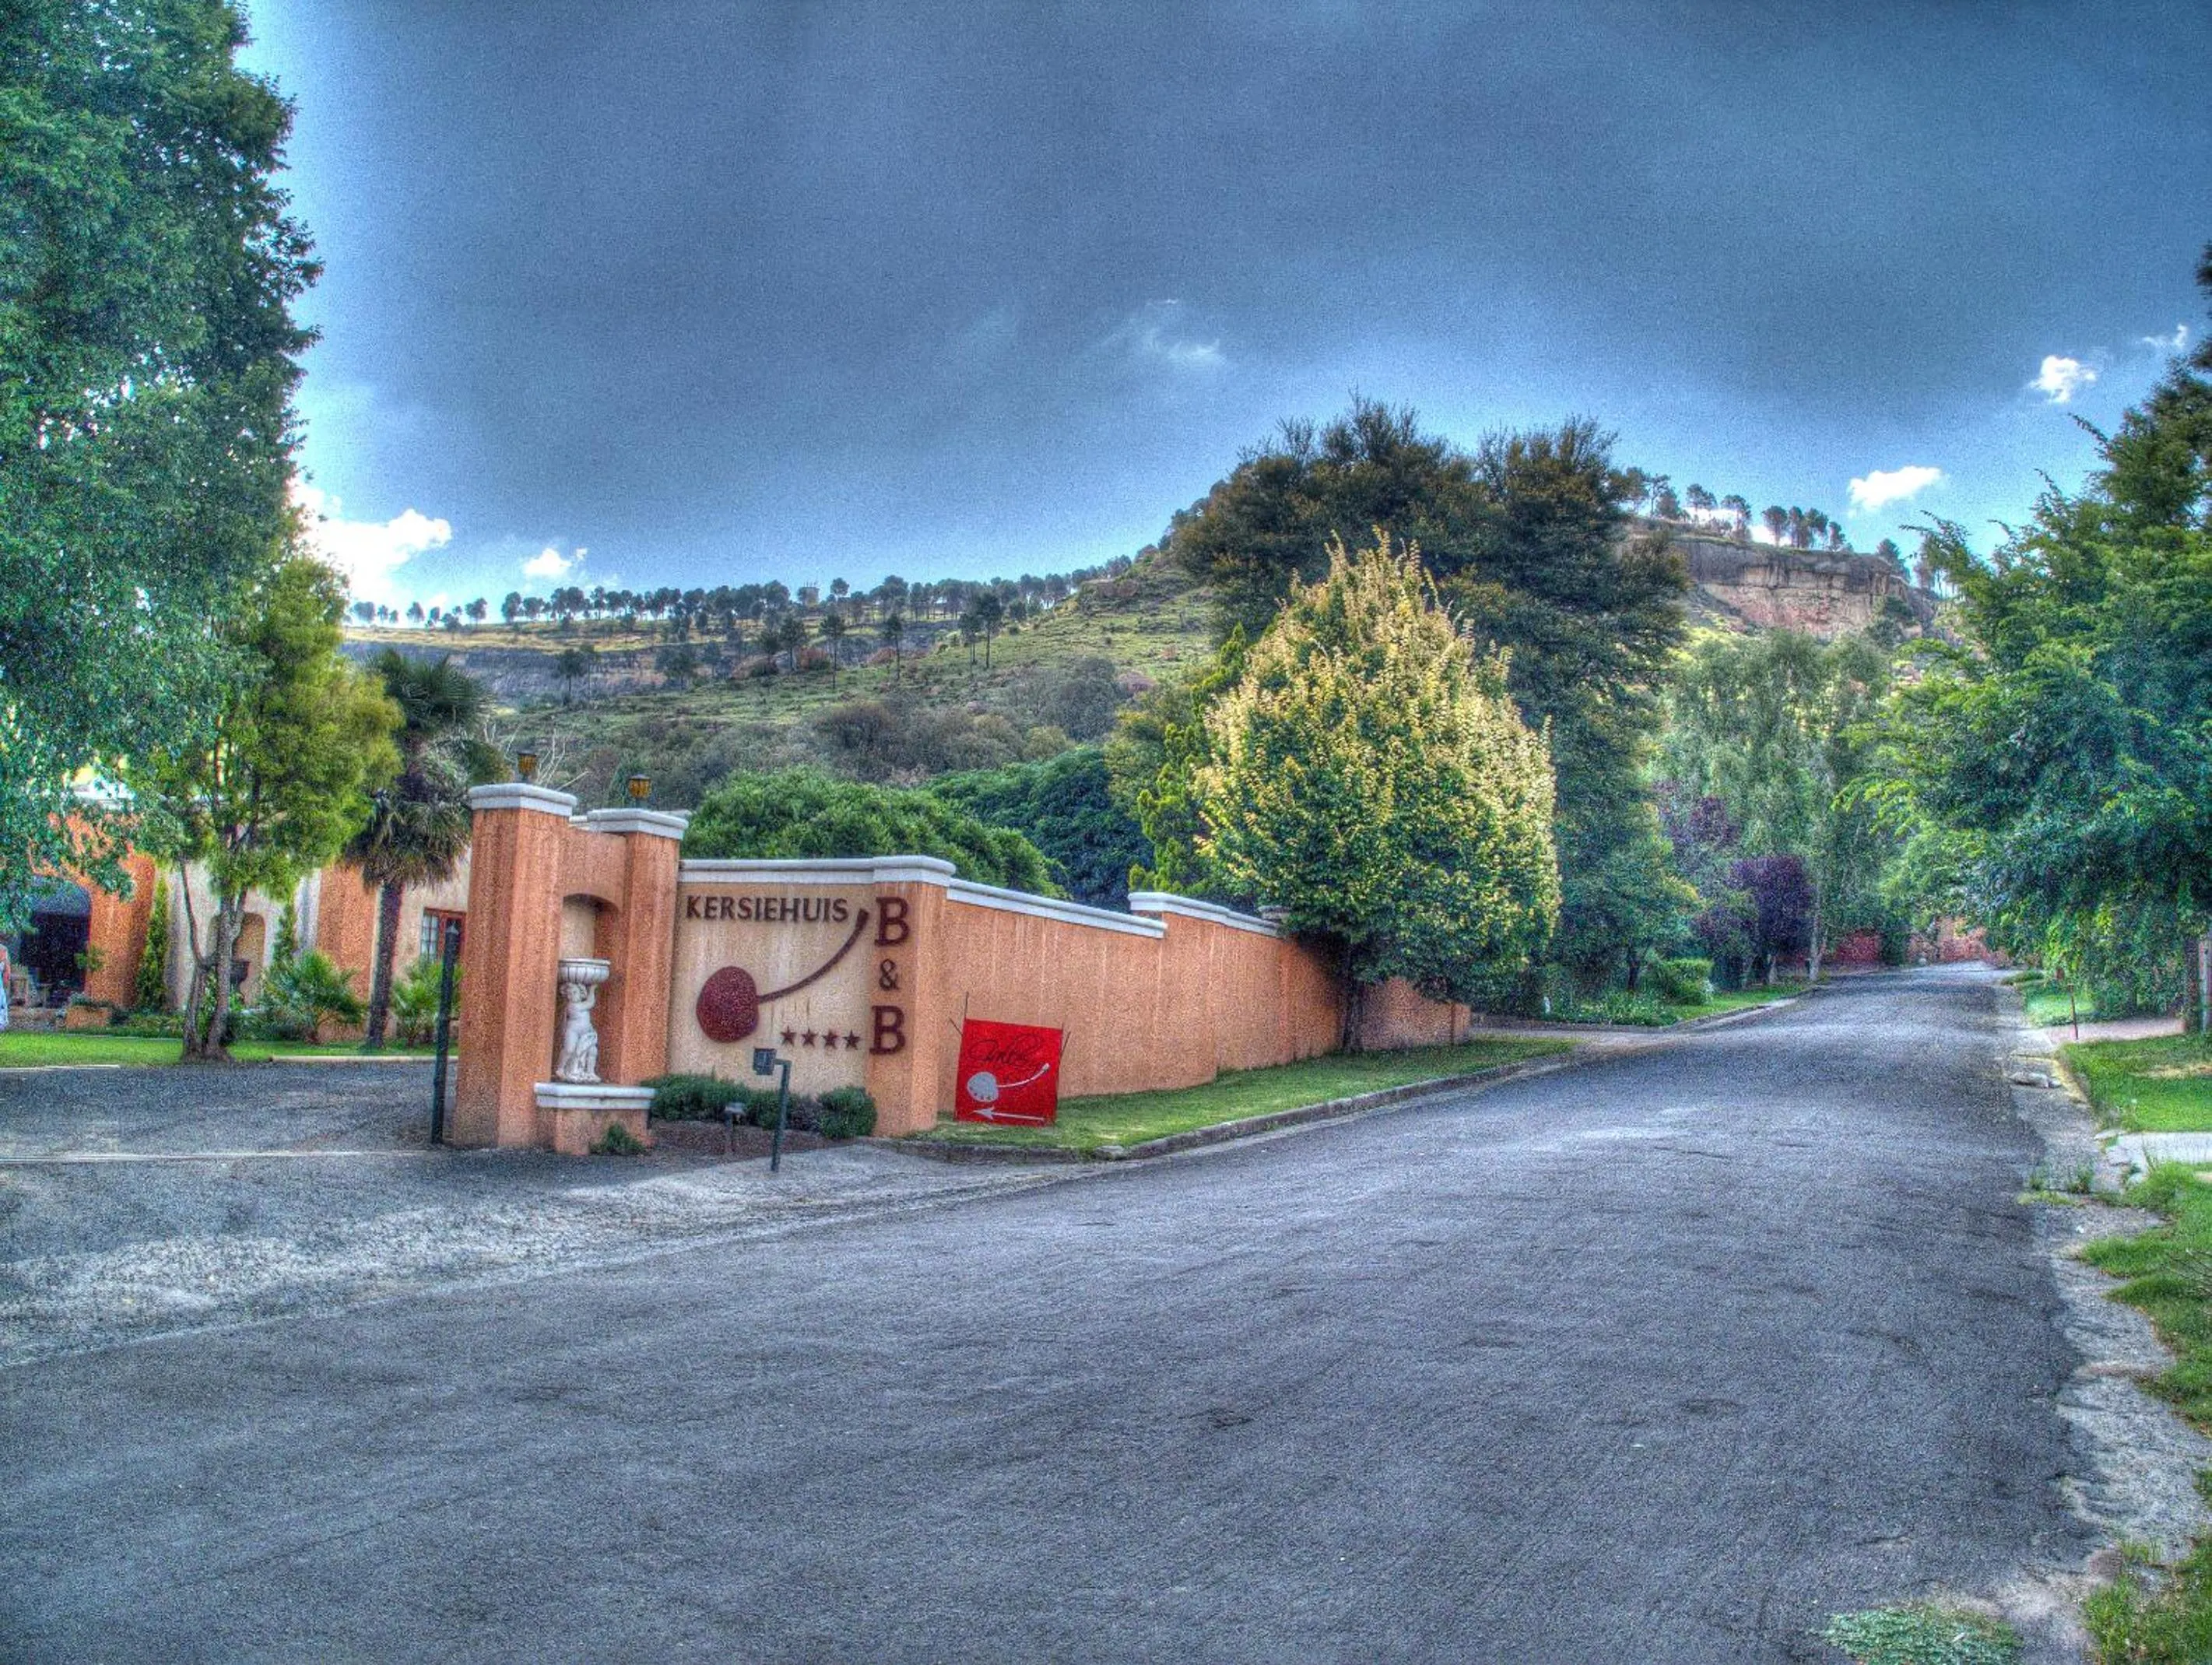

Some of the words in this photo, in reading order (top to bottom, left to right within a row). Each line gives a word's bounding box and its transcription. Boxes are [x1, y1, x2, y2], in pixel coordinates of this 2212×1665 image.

[685, 896, 849, 923] KERSIEHUIS
[874, 896, 911, 947] B
[878, 958, 901, 992] &
[869, 1005, 906, 1056] B
